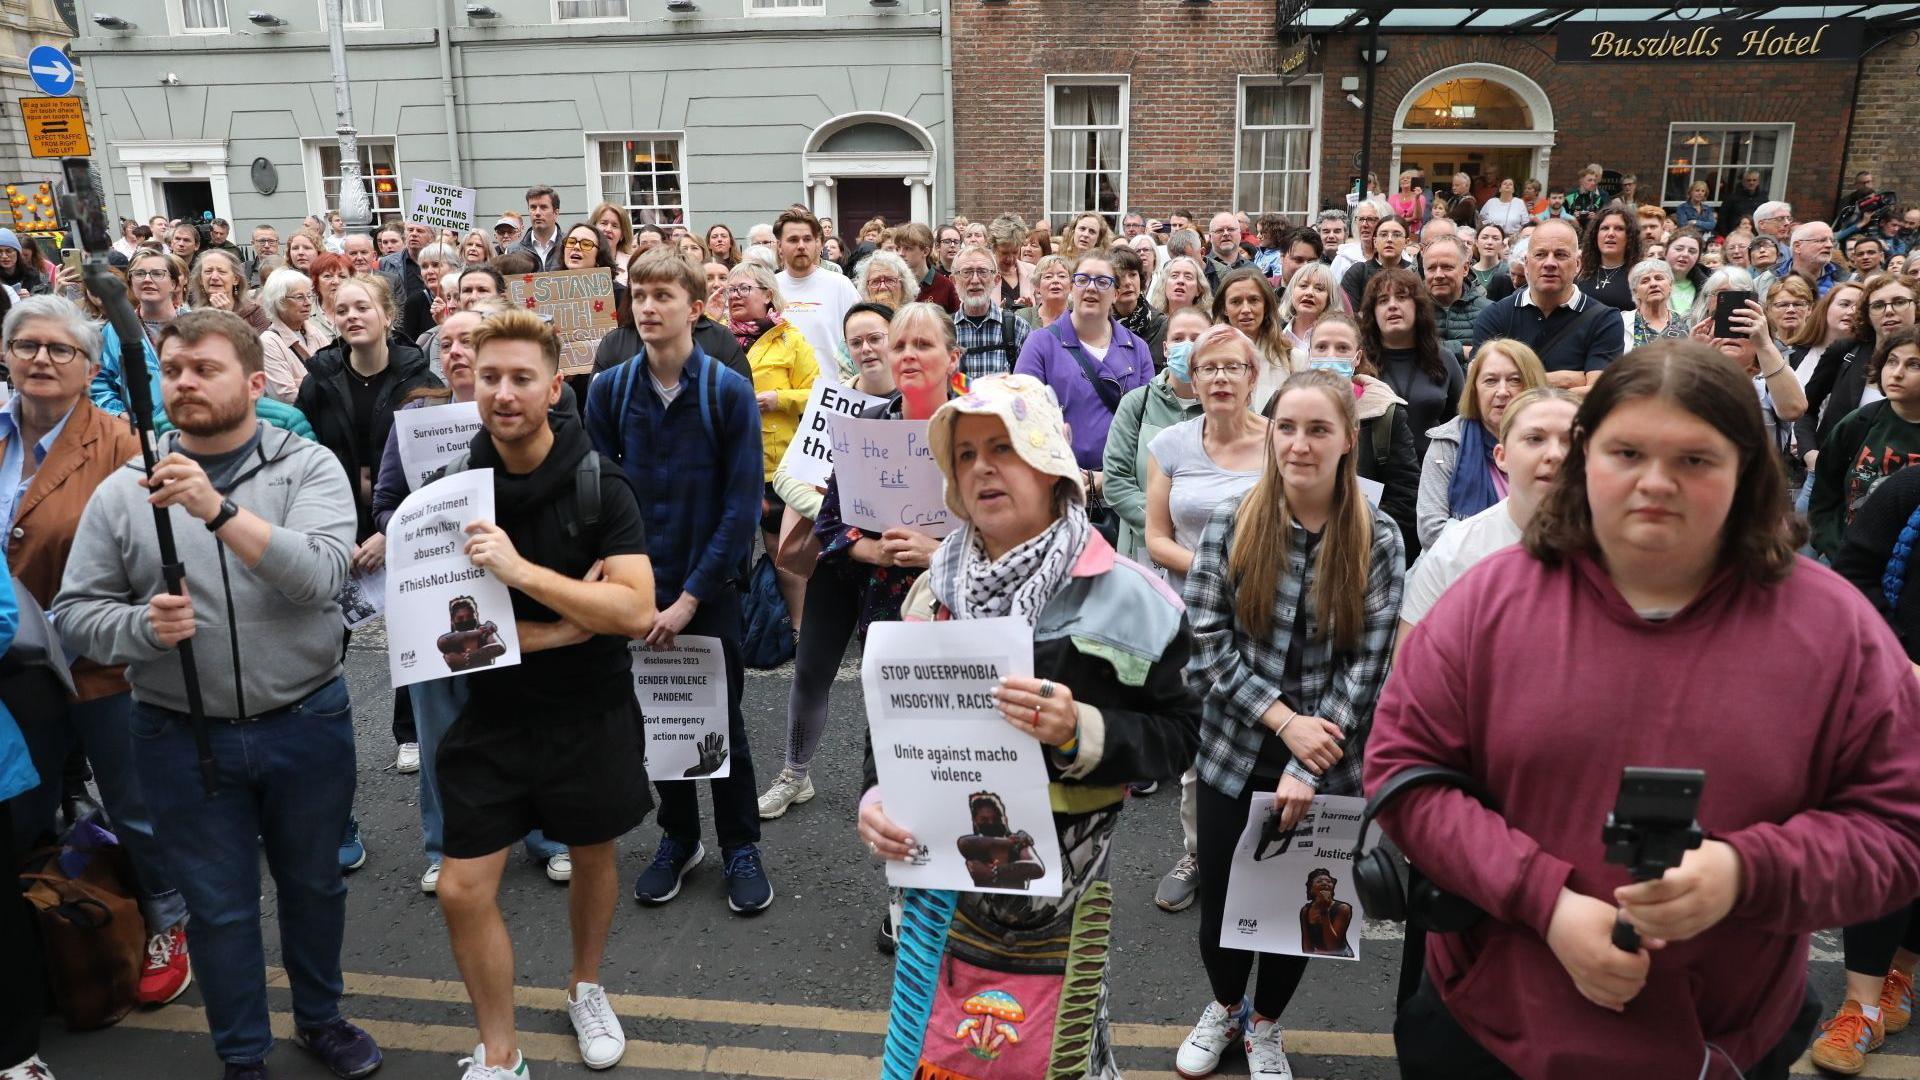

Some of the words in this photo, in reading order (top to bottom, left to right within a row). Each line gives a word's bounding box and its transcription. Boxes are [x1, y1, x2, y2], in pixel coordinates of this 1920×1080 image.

[1590, 26, 1722, 58] Buswells
[1736, 24, 1830, 56] Hotel
[425, 184, 463, 198] JUSTICE
[434, 196, 452, 207] FOR
[431, 206, 467, 220] VICTIMS
[412, 213, 424, 223] OF
[427, 216, 470, 231] VIOLENCE
[534, 273, 612, 302] STAND
[820, 387, 866, 418] End
[413, 427, 454, 439] Survivors
[455, 422, 482, 433] harme
[437, 443, 445, 454] in
[862, 438, 889, 459] the
[400, 507, 424, 525] Special
[426, 496, 469, 515] Treatment
[853, 499, 876, 519] the
[404, 531, 414, 542] for
[414, 541, 455, 560] abusers?
[400, 567, 486, 593] #ThisIsNotJustice
[684, 646, 711, 654] violence
[643, 657, 682, 665] disclosures
[683, 657, 700, 665] 2023
[881, 665, 910, 680] STOP
[914, 664, 999, 680] QUEERPHOBIA
[638, 676, 668, 685] GENDER
[671, 676, 707, 685] VIOLENCE
[653, 692, 693, 702] PANDEMIC
[891, 694, 955, 710] MISOGYNY,
[957, 693, 994, 709] RACIS
[662, 716, 705, 726] emergency
[653, 732, 677, 741] action
[679, 733, 695, 741] now
[894, 744, 924, 760] Unite
[927, 745, 972, 764] against
[974, 747, 1018, 761] macho
[931, 766, 982, 782] violence
